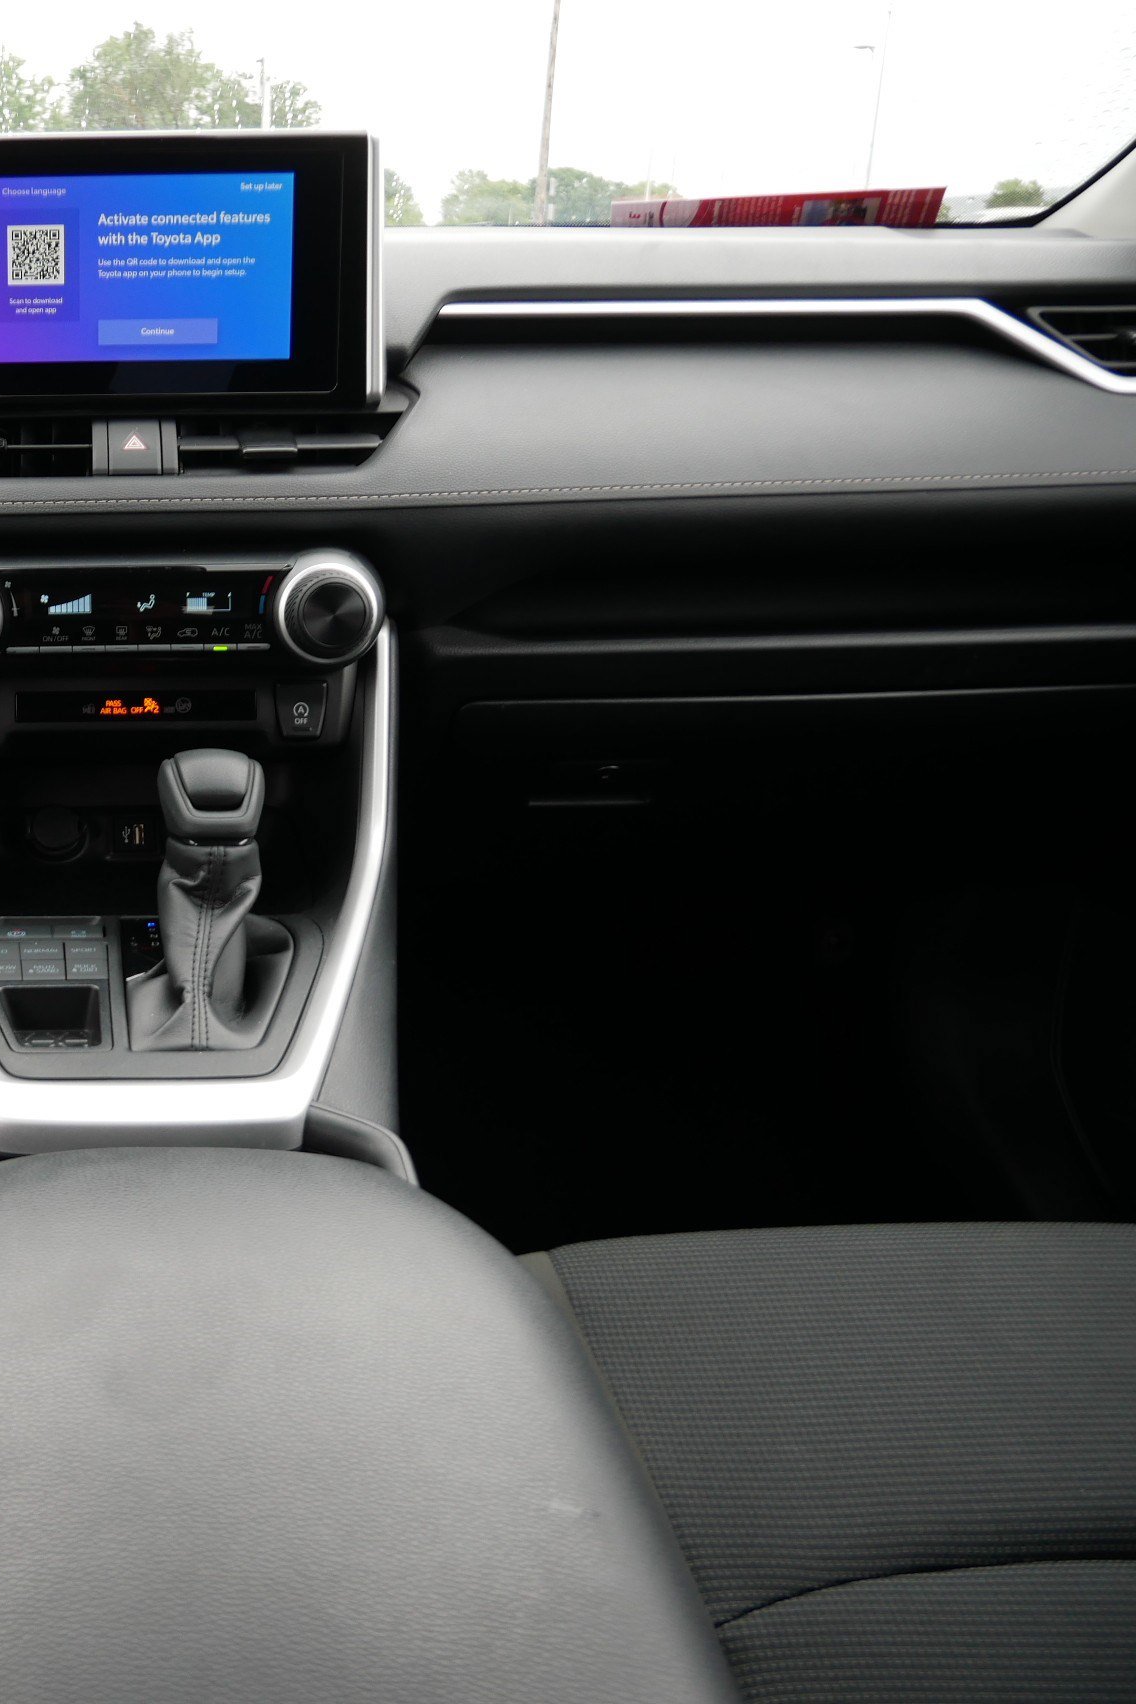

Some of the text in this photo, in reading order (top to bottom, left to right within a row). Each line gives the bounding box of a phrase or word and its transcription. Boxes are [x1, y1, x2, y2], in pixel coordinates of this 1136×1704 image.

[240, 181, 283, 192] Set up later
[2, 187, 66, 197] Choose language
[98, 211, 271, 226] Activate connected features
[98, 231, 221, 247] with the Toyota App
[98, 258, 111, 266] Use
[113, 258, 124, 266] the
[126, 257, 138, 266] QR
[139, 257, 157, 265] code
[167, 256, 205, 265] download
[207, 256, 221, 264] and
[222, 257, 242, 266] open
[243, 256, 255, 264] the
[98, 269, 121, 279] Toyota
[122, 270, 137, 278] app
[149, 270, 166, 278] your
[167, 268, 192, 278] phone
[202, 268, 222, 278] begin
[224, 268, 247, 277] setup.
[32, 296, 63, 304] download
[27, 307, 43, 315] open
[44, 307, 57, 315] app
[141, 327, 175, 335] Continue
[211, 627, 230, 637] A/C
[244, 630, 262, 639] A/C
[130, 706, 144, 714] OFF
[295, 717, 308, 725] OFF
